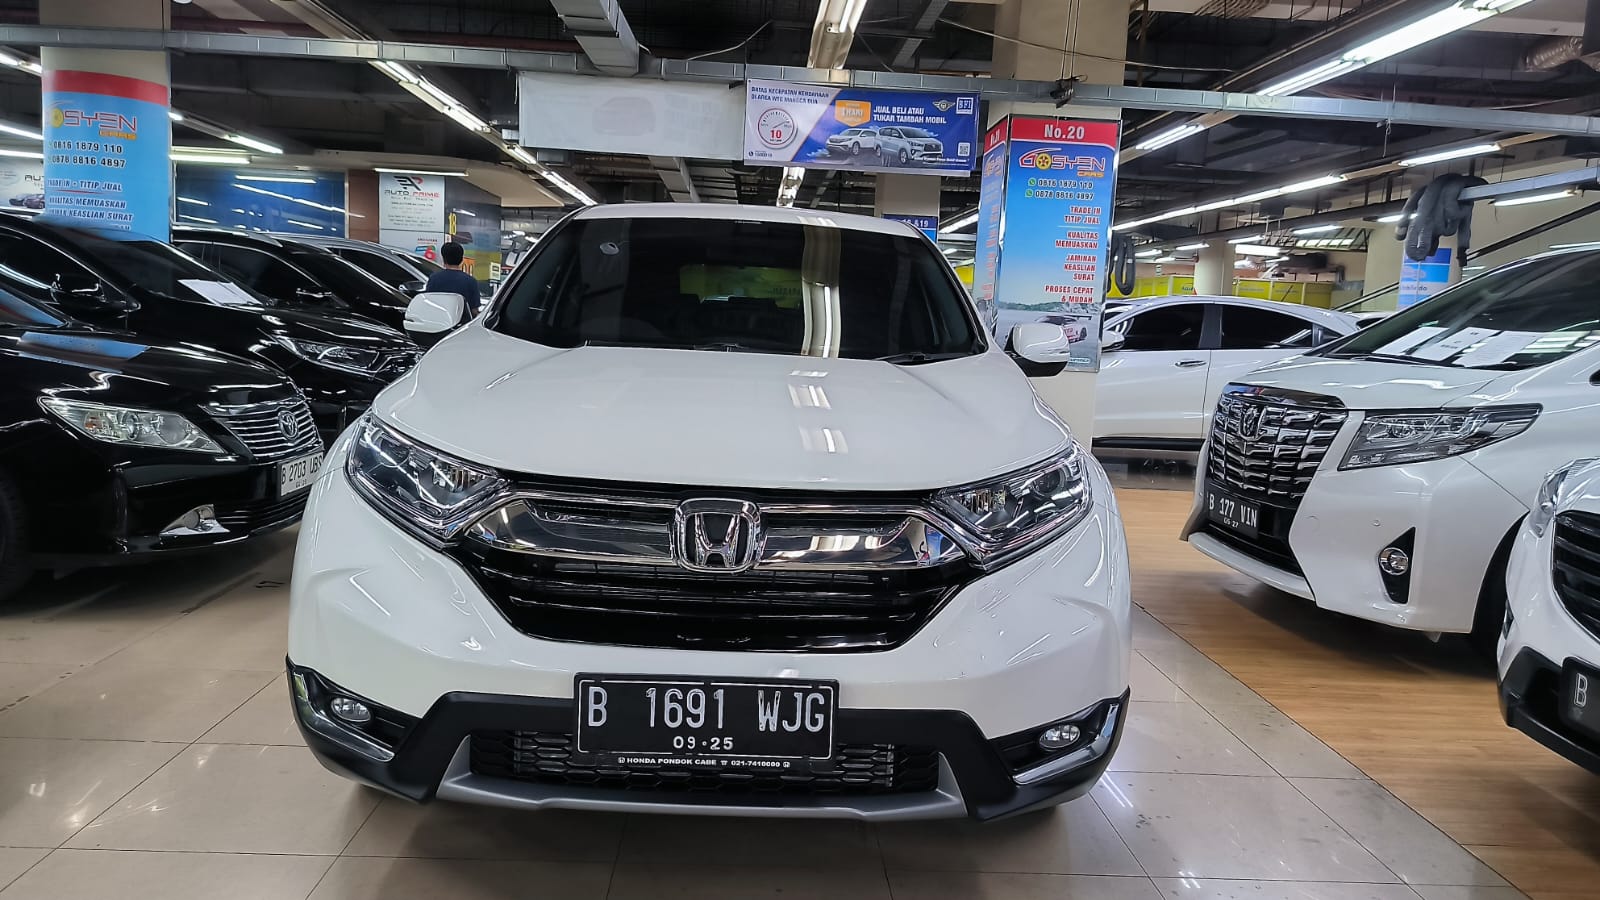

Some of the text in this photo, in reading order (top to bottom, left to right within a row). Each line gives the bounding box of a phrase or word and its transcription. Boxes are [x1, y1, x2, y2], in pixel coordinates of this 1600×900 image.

[873, 105, 925, 115] JUAL BELI ATAU
[873, 114, 947, 124] TUKAR TAMBAH MOBIL
[770, 130, 782, 139] 10
[1044, 124, 1085, 140] No.20
[53, 141, 123, 154] 0816 1879 110
[72, 156, 97, 165] 8816
[100, 158, 126, 168] 4897
[79, 181, 100, 190] TITIP
[102, 183, 123, 191] JUAL
[1038, 179, 1093, 189] 0816 1879 110
[412, 191, 440, 199] PRIME
[1035, 190, 1094, 200] 0878 8816 4897
[75, 197, 126, 209] MEMUASKAN
[69, 209, 105, 219] KEASLIAN
[107, 212, 133, 221] SURAT
[1071, 206, 1102, 215] TRADE IN
[1064, 215, 1100, 224] TITIP JUAL
[1067, 231, 1098, 239] KUALITAS
[1055, 240, 1098, 249] MEMUASKAN
[1066, 255, 1096, 263] JAMINAN
[1064, 264, 1096, 272] KEASLIAN
[1073, 273, 1095, 281] SURAT
[1045, 285, 1094, 295] PROSES CEPAT
[1069, 295, 1093, 304] MUDAH
[281, 467, 286, 485] B
[289, 460, 307, 482] 2703
[1209, 493, 1257, 528] B 177 VIN
[1573, 672, 1588, 708] B
[587, 686, 825, 733] B 1691 WJG
